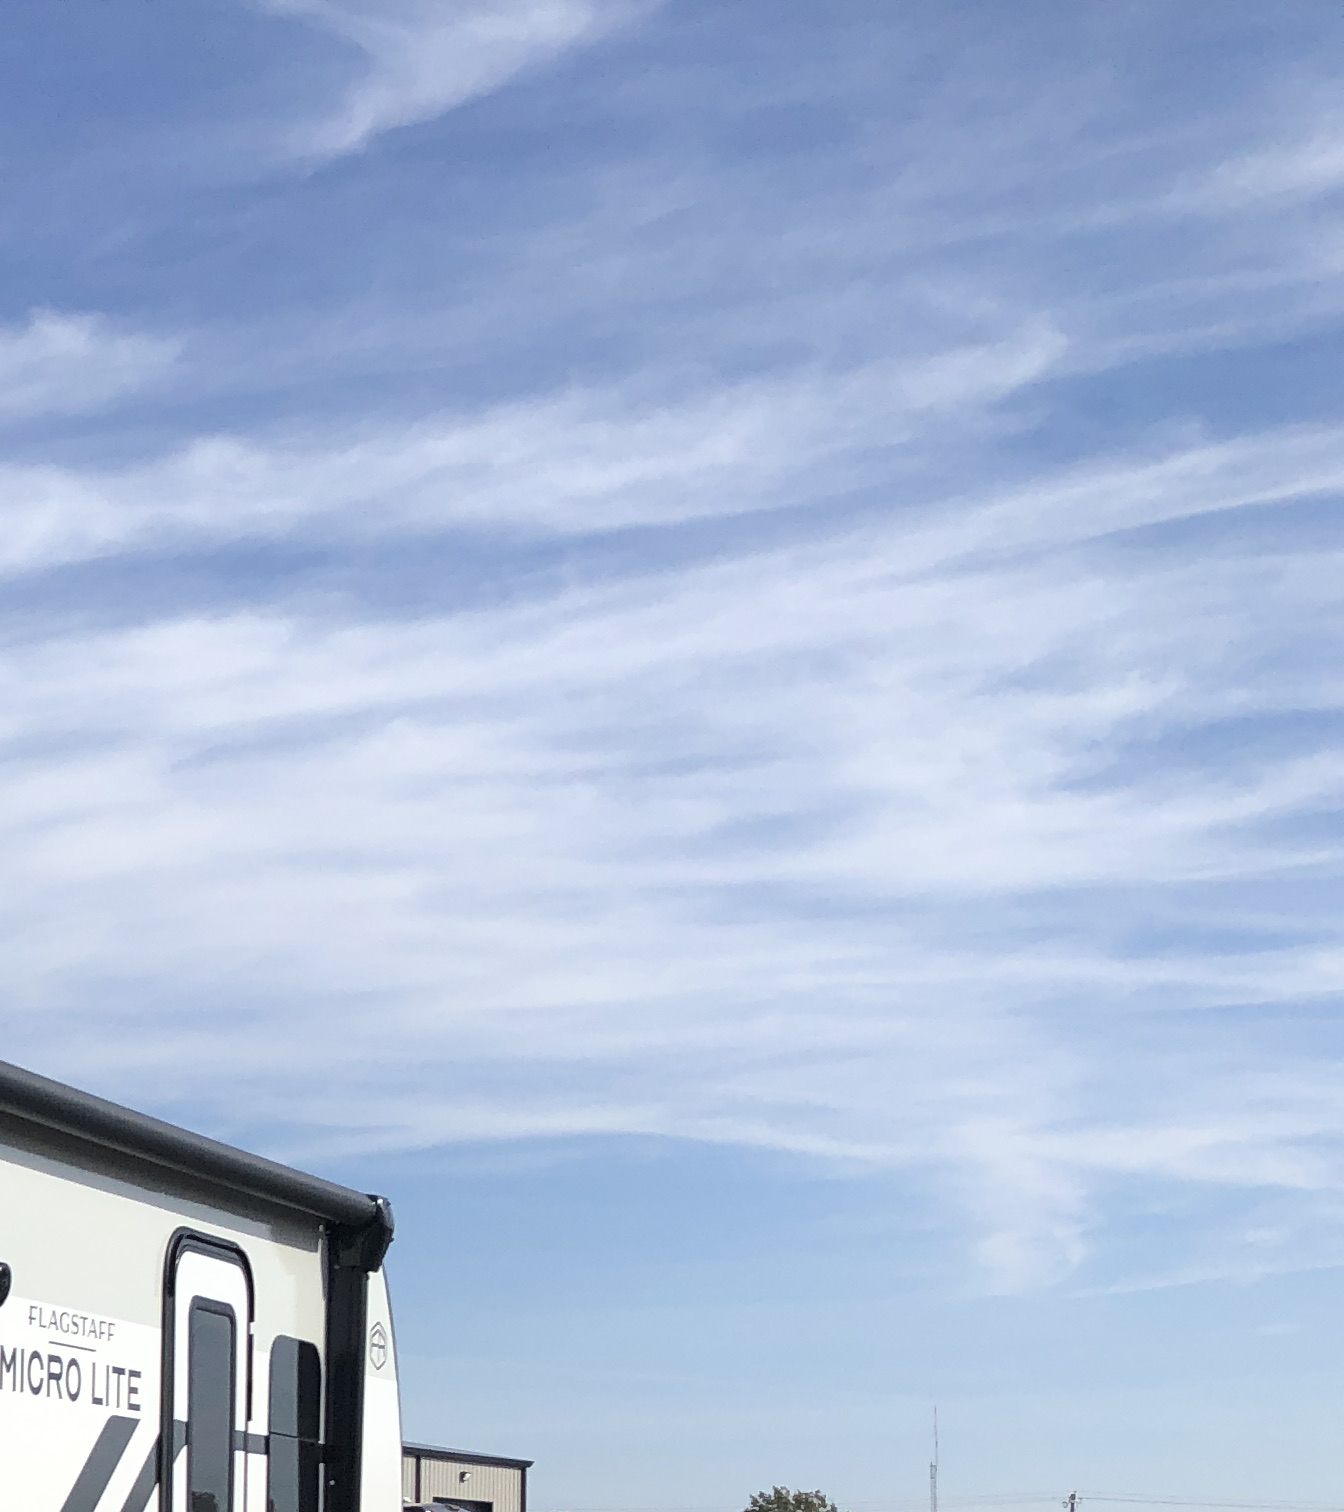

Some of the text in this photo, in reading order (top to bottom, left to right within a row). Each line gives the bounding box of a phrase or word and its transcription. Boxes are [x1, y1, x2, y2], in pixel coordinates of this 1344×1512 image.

[28, 1305, 116, 1341] FLAGSTAFF
[0, 1345, 142, 1411] MICRO LITE
